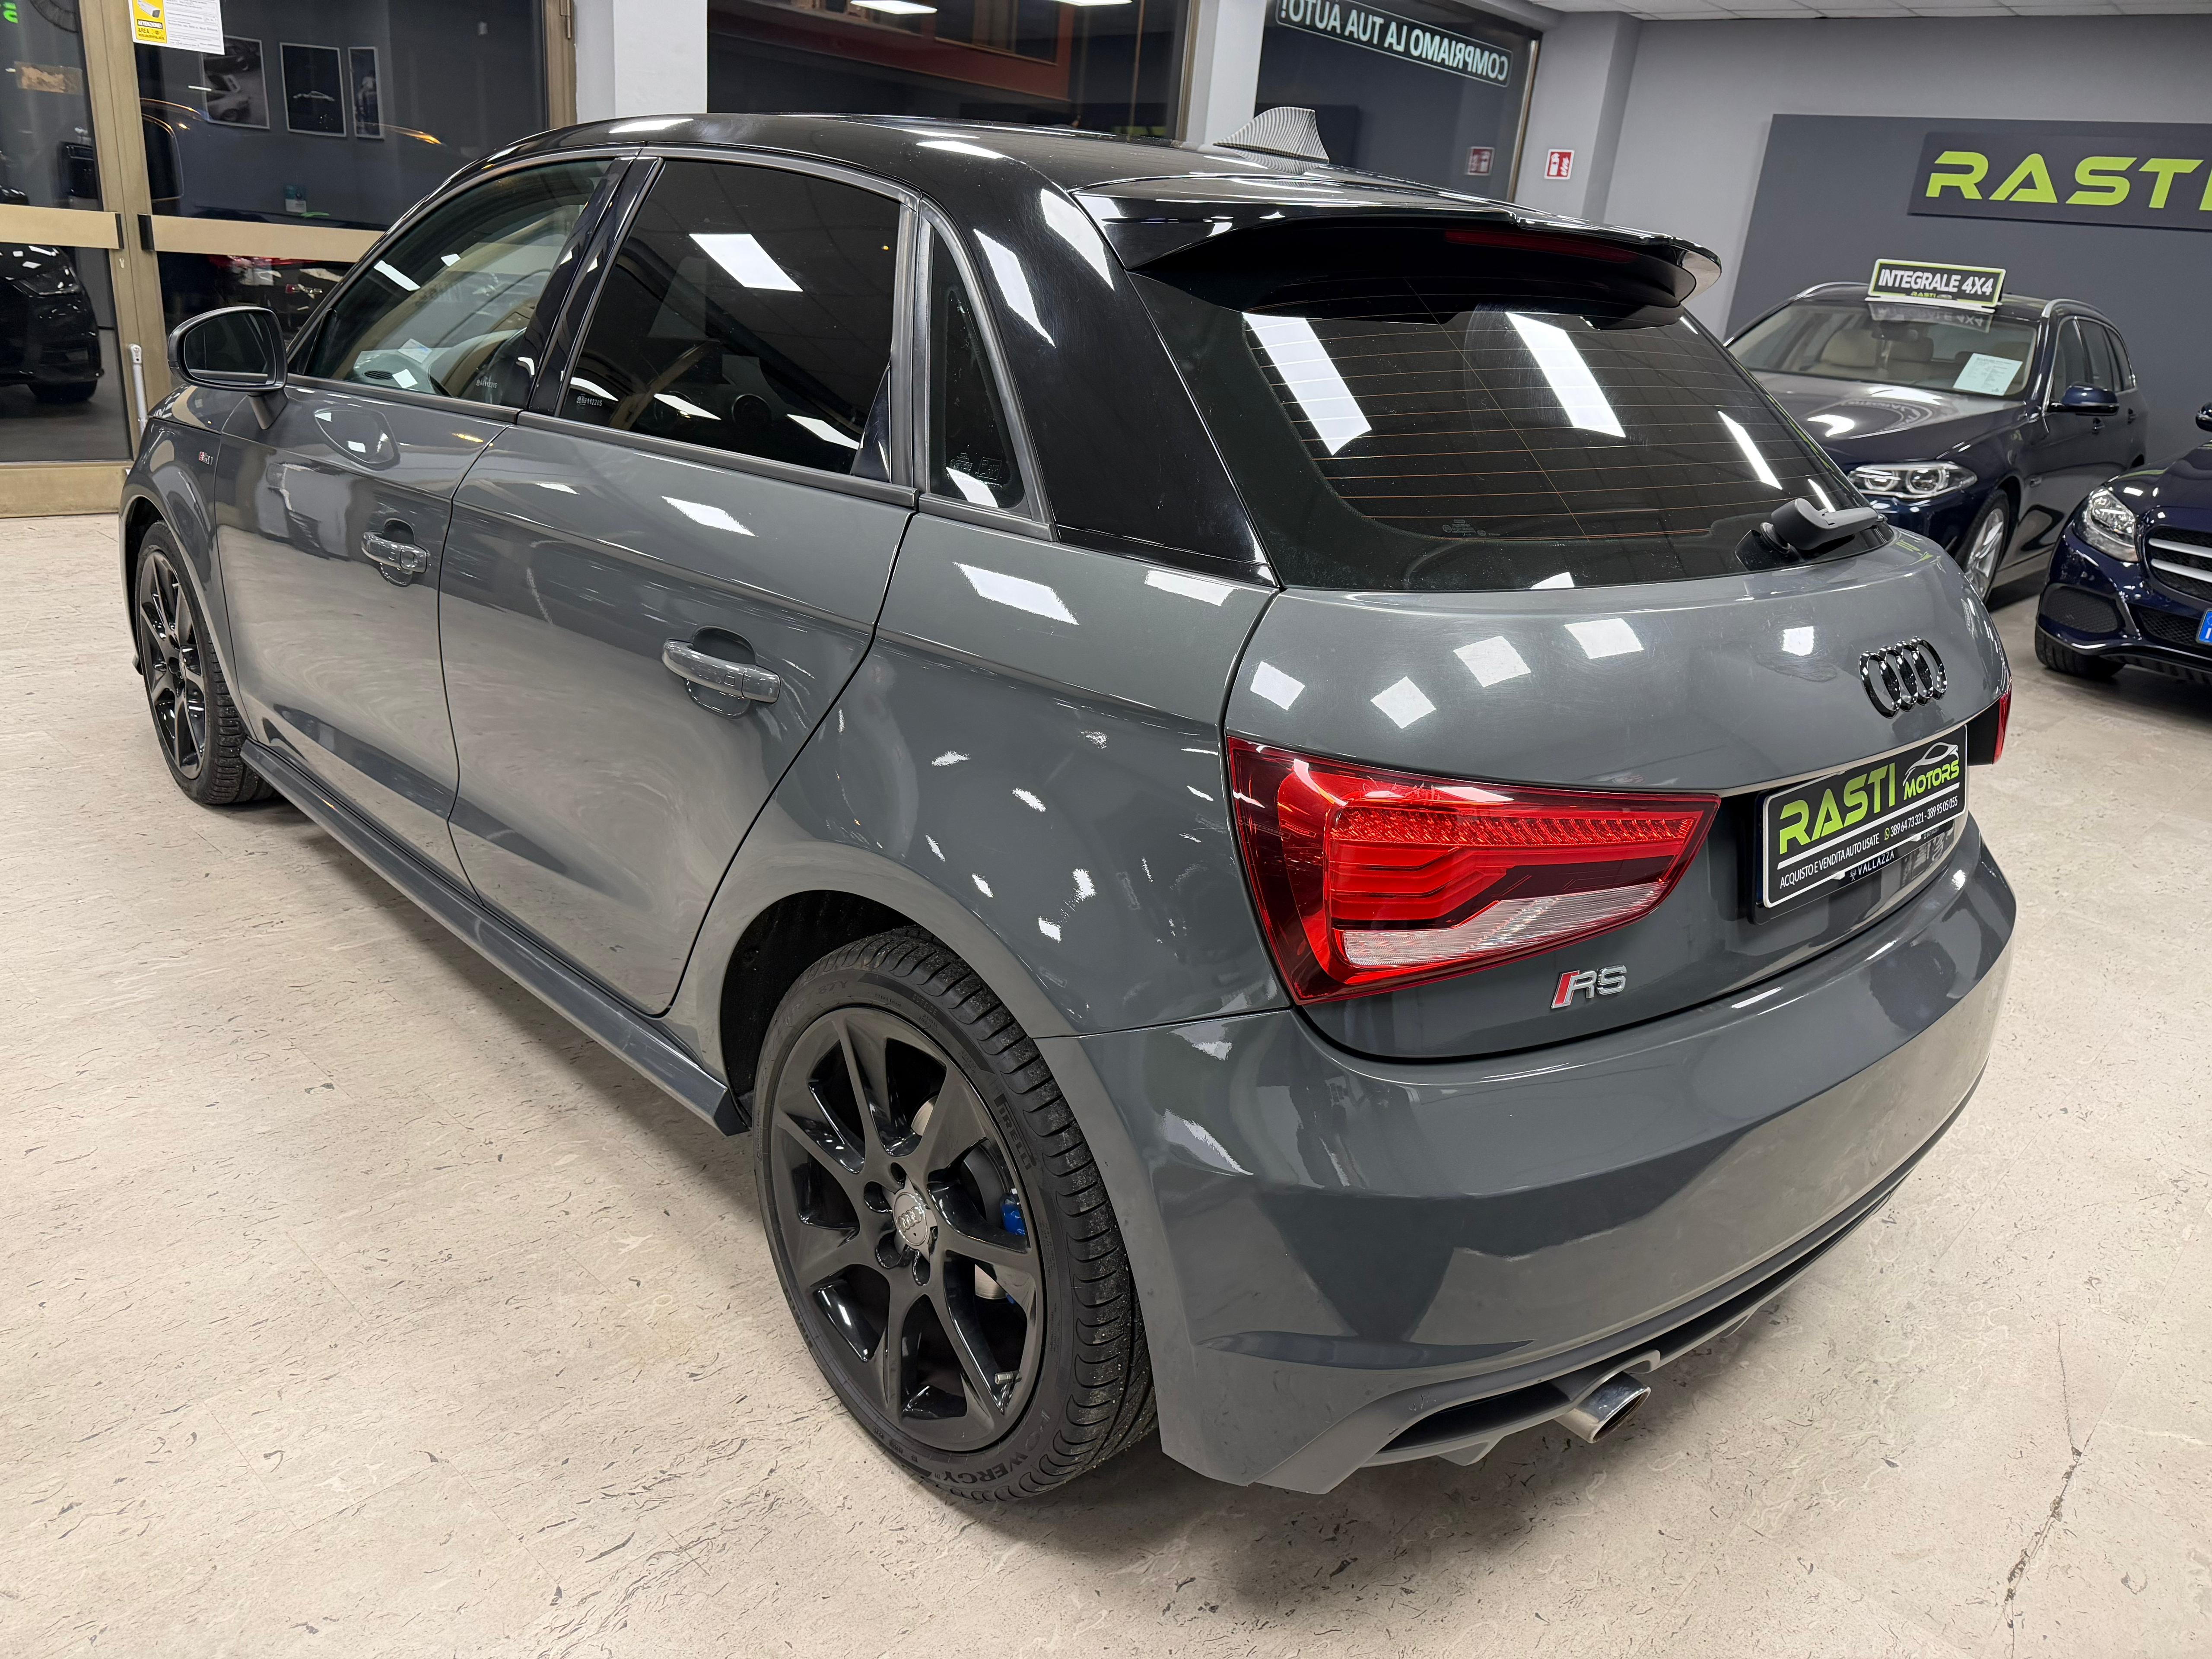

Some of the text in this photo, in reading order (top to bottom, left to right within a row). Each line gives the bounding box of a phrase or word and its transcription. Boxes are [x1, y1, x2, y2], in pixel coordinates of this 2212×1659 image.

[1878, 269, 1994, 296] INTEGRALE 4X4
[1904, 759, 1960, 801] MOTORS
[1779, 762, 1896, 855] RASTI
[1780, 864, 1814, 889] ACQUISTO
[1814, 861, 1818, 873] E
[1818, 849, 1845, 871] VENDITA
[1845, 841, 1862, 859] AUTO
[1862, 833, 1880, 851] USATE
[1890, 823, 1900, 836] 389
[1901, 820, 1907, 832] 64
[1907, 816, 1914, 828] 73
[1915, 812, 1924, 825] 321
[1927, 806, 1936, 819] 389
[1936, 803, 1942, 814] 95
[1942, 799, 1948, 811] 05
[1949, 795, 1958, 809] 055
[1857, 849, 1894, 876] VALLAZZA
[1550, 964, 1627, 1009] RS
[994, 1093, 1036, 1171] PIRELLI
